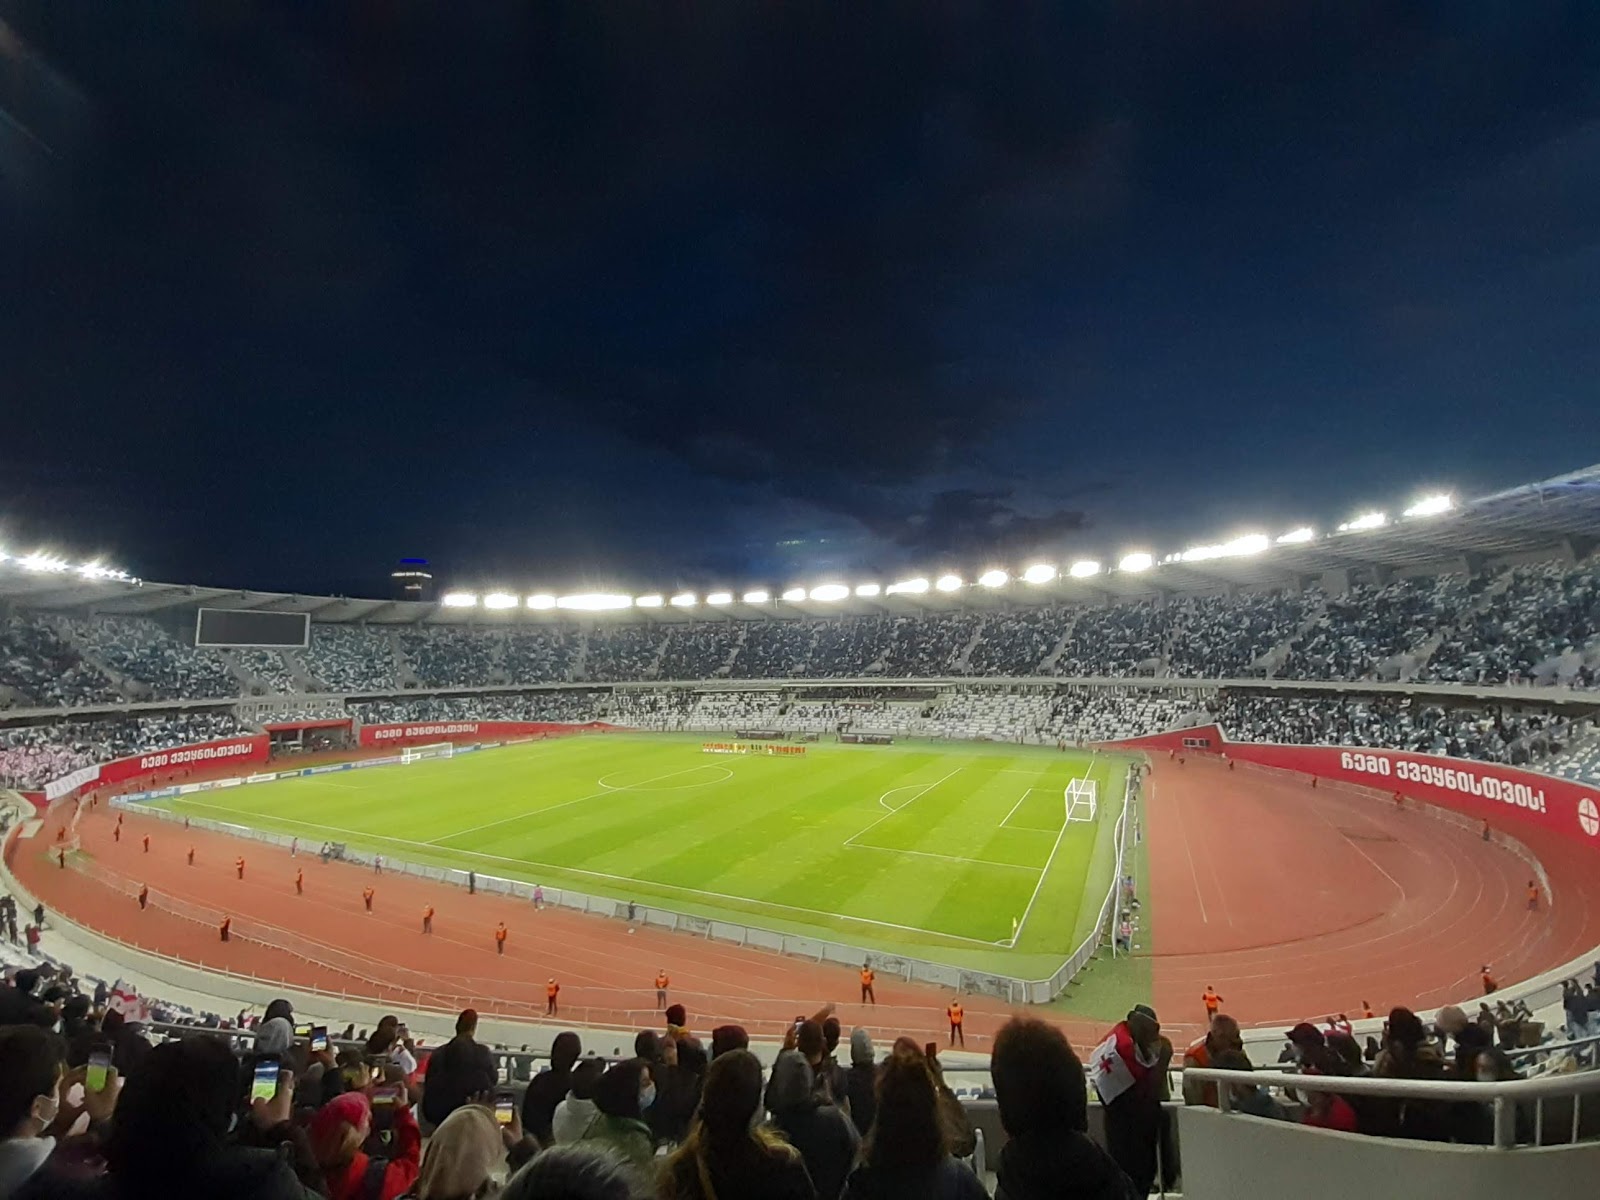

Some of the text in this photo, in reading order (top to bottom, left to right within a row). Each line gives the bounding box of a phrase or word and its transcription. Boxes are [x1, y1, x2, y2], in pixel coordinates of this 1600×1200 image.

[141, 755, 168, 769] ჩემი
[1341, 752, 1547, 814] ჩემი ქვეყნისთვის!
